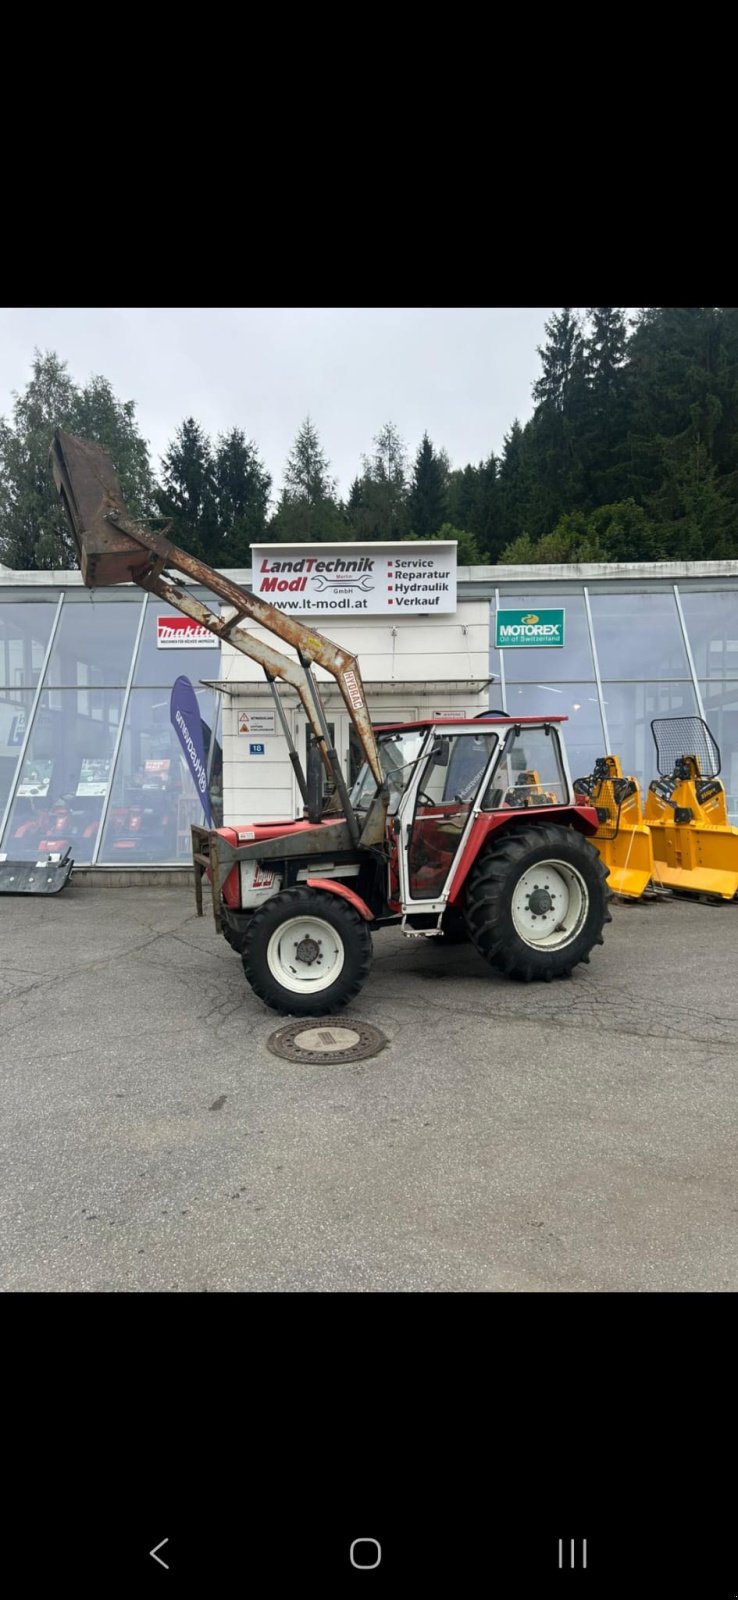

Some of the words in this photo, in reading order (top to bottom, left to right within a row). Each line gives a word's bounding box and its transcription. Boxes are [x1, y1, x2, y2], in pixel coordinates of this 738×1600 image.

[260, 558, 375, 573] LandTechnik
[395, 559, 434, 568] Service
[395, 570, 450, 581] Reparatur
[260, 577, 308, 592] Modl
[395, 583, 449, 594] Hydraulik
[395, 596, 440, 606] Verkauf
[500, 624, 560, 636] MOTOREX
[344, 672, 363, 708] HYDRAC
